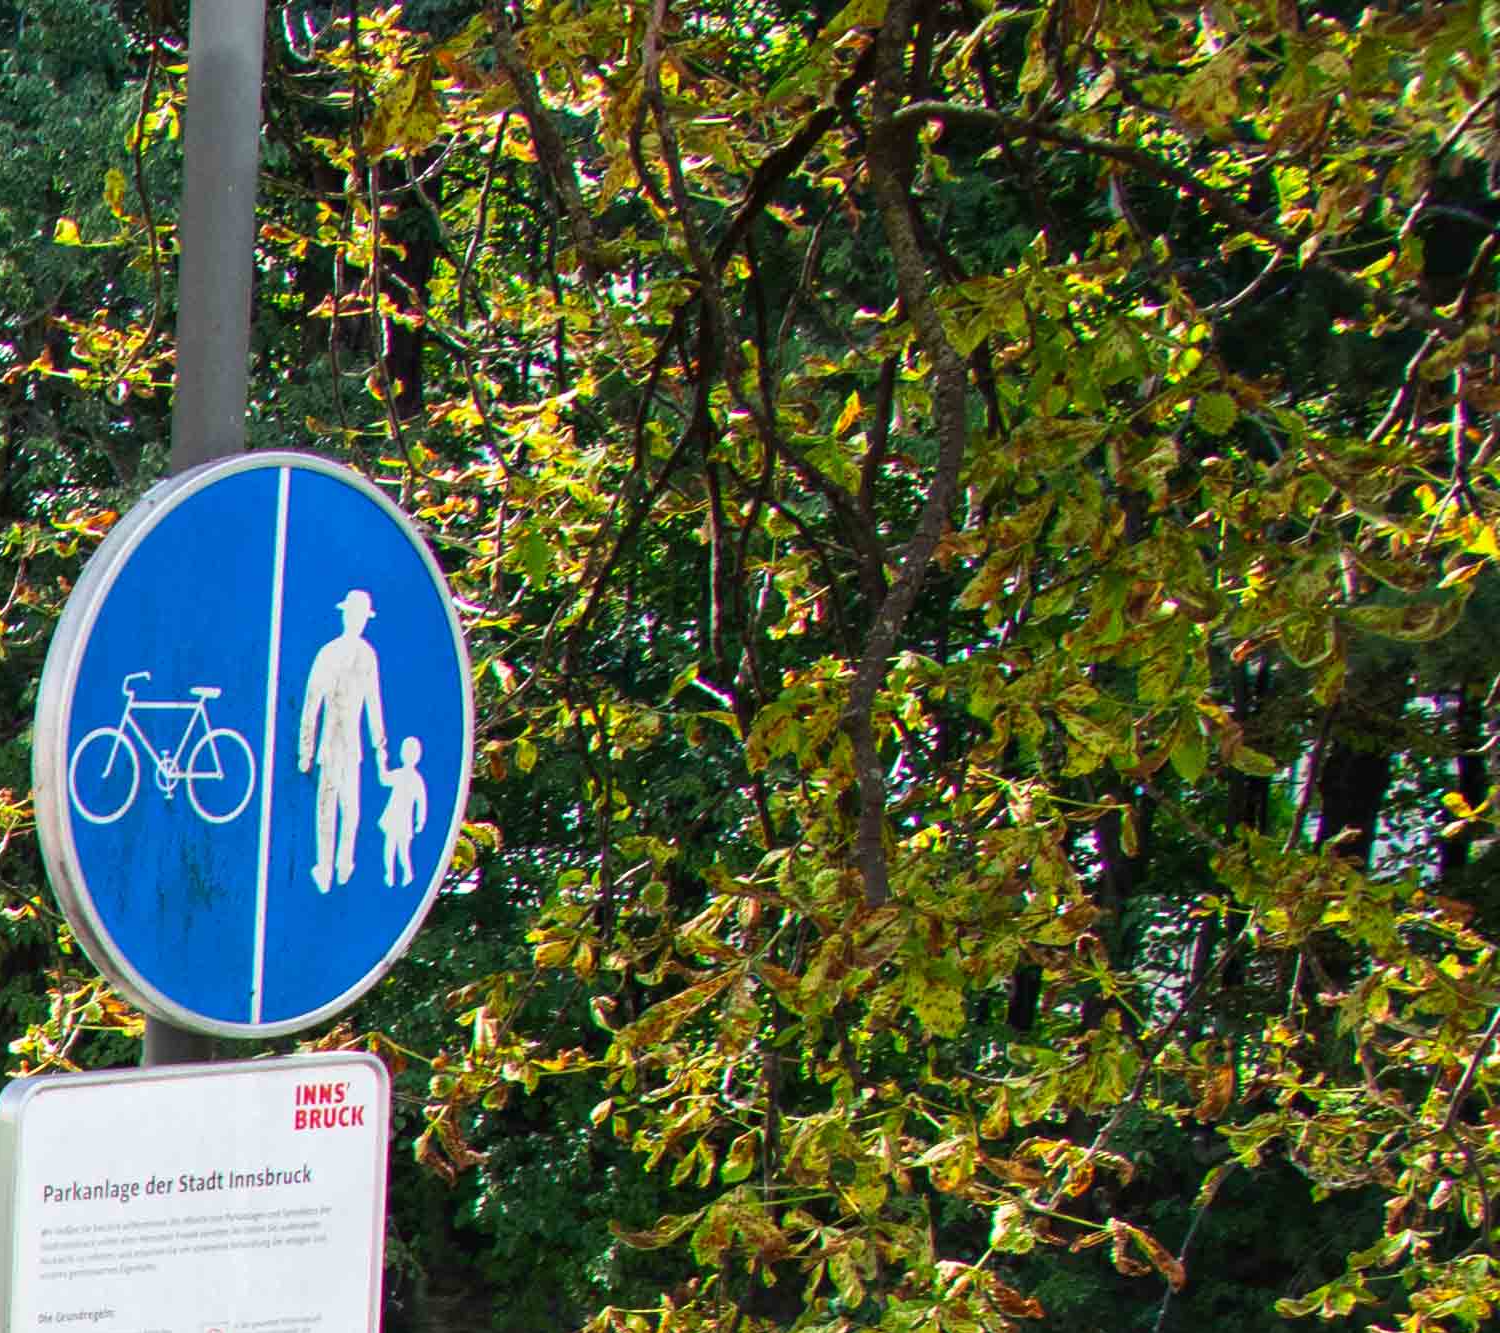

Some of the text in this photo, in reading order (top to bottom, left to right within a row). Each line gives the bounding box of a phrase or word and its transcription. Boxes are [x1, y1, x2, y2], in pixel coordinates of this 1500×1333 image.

[295, 1105, 364, 1130] BRUCK
[43, 1163, 312, 1203] Parkanlage der Stadt Innsbruck
